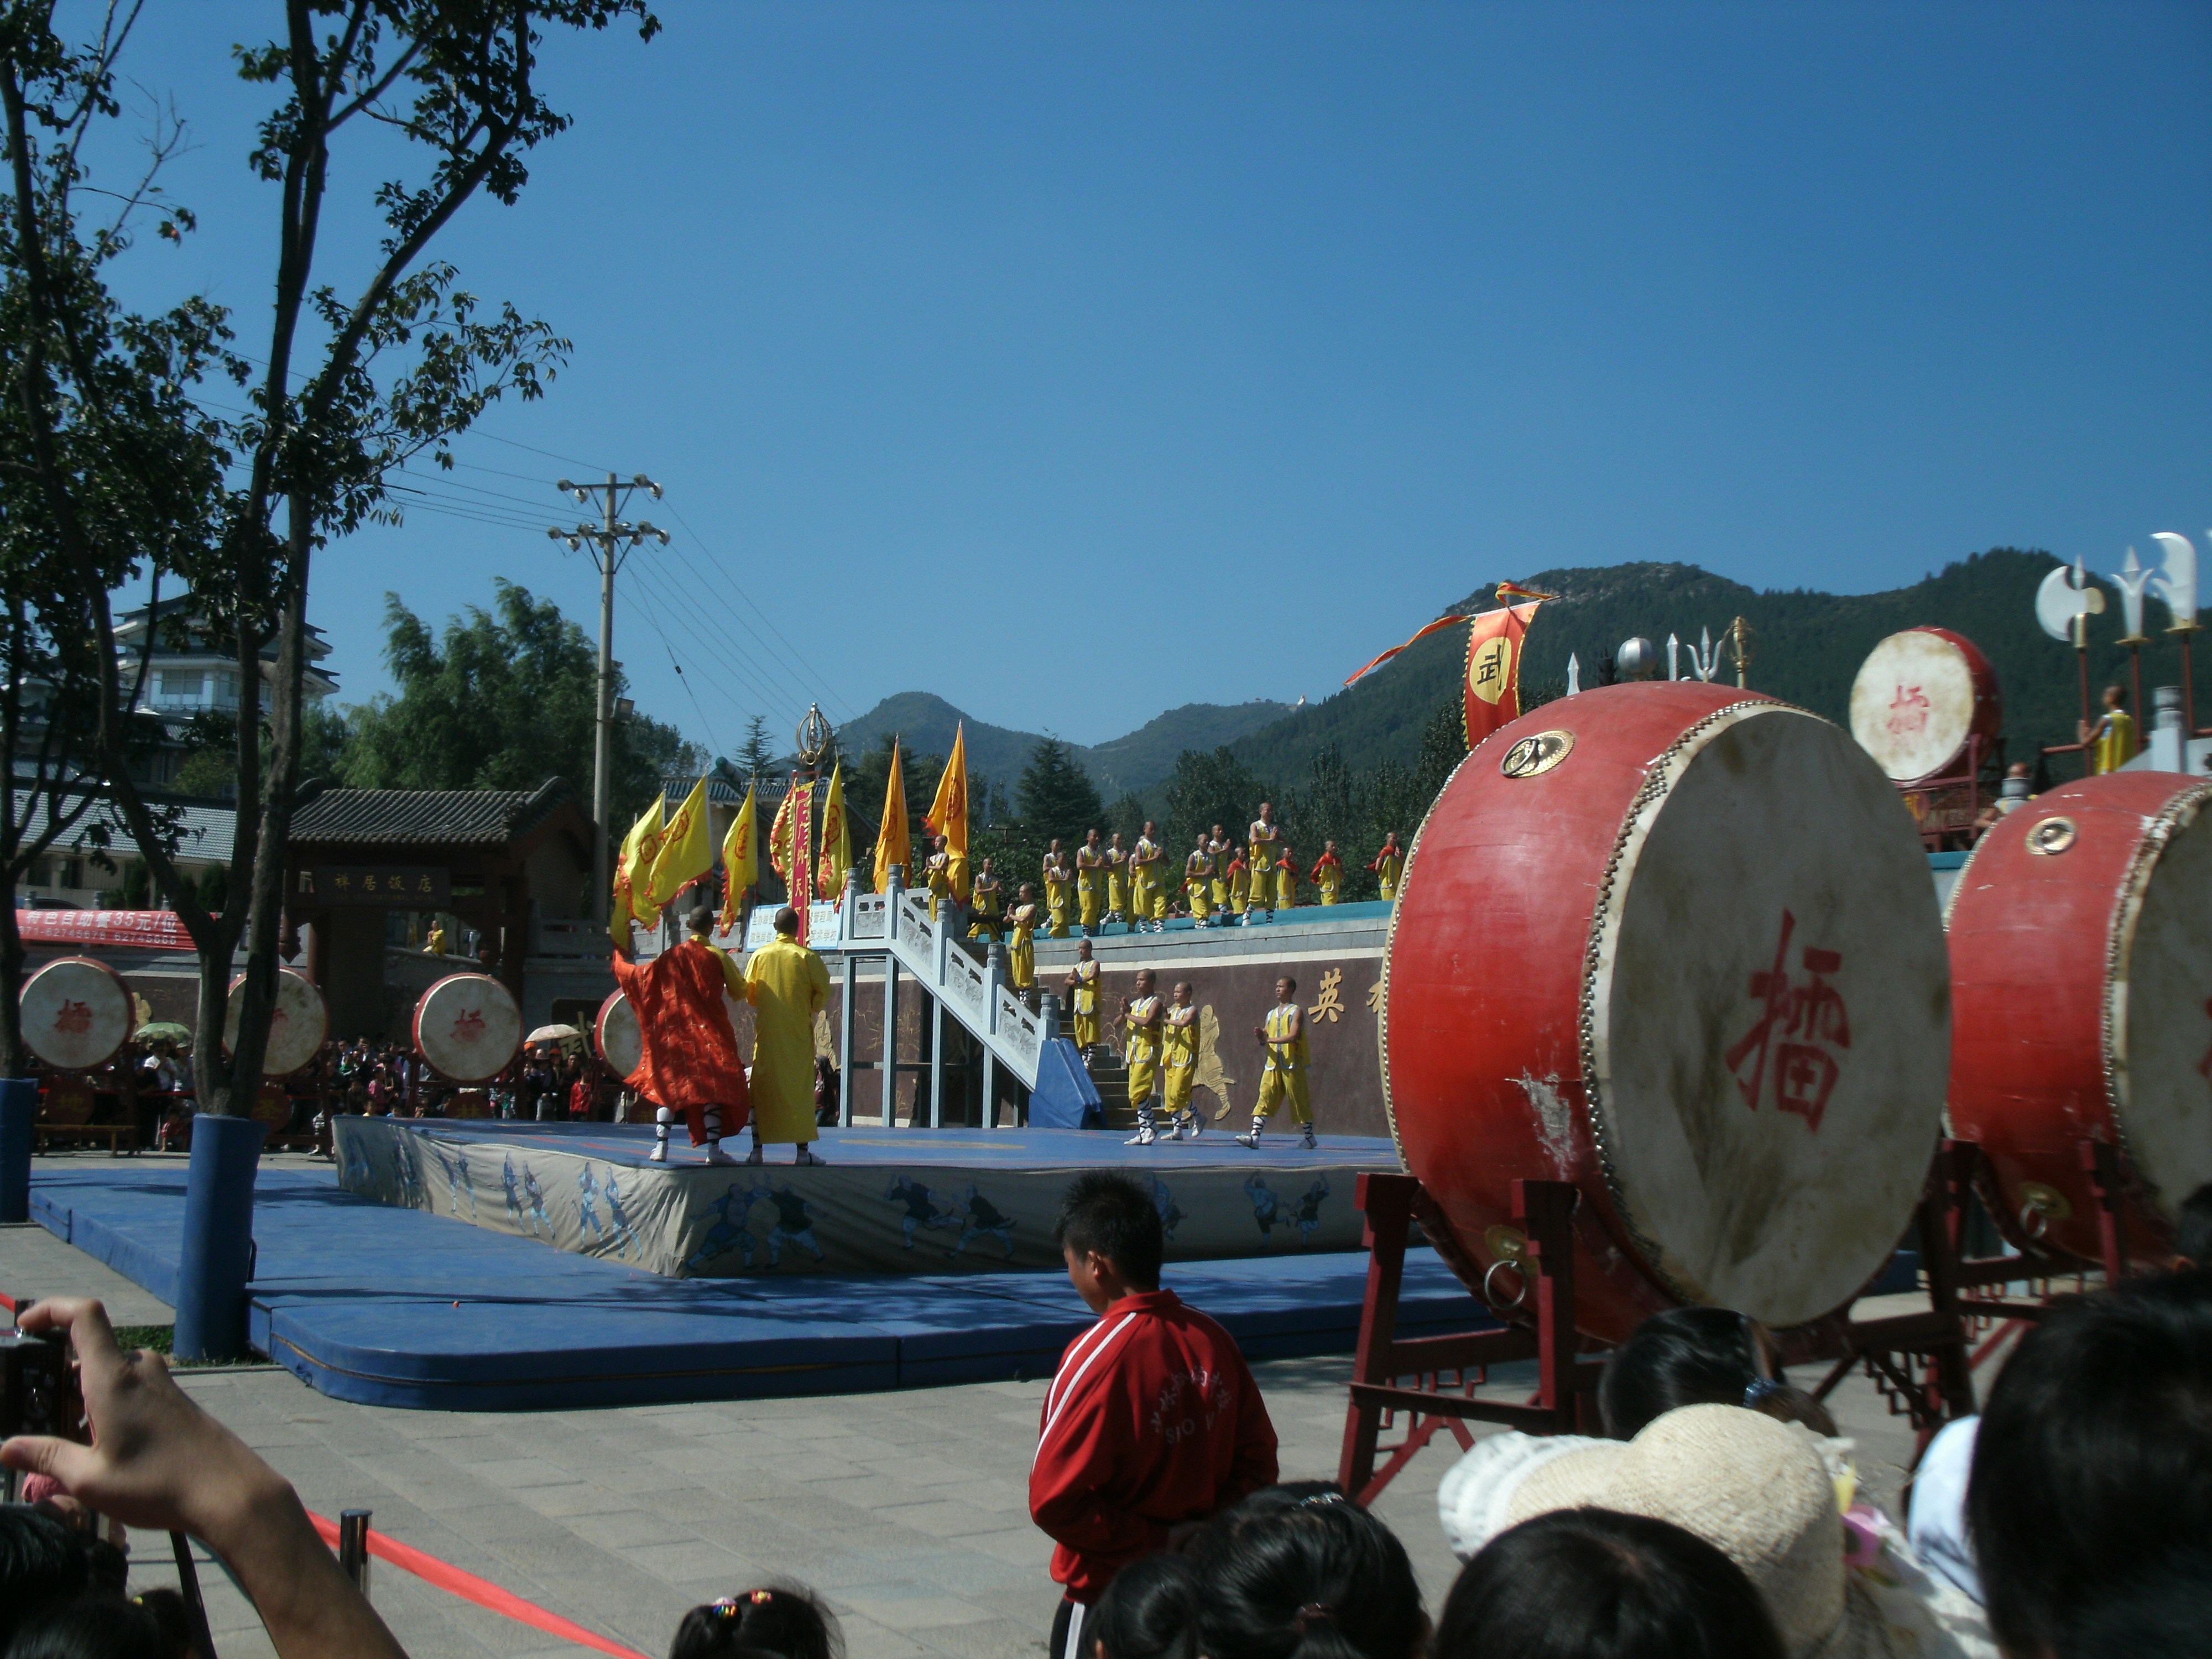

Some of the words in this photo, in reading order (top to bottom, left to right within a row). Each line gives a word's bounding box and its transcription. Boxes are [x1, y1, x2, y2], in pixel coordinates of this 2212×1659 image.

[1477, 644, 1503, 691] 武
[26, 911, 178, 933] 特色自助餐35元/位
